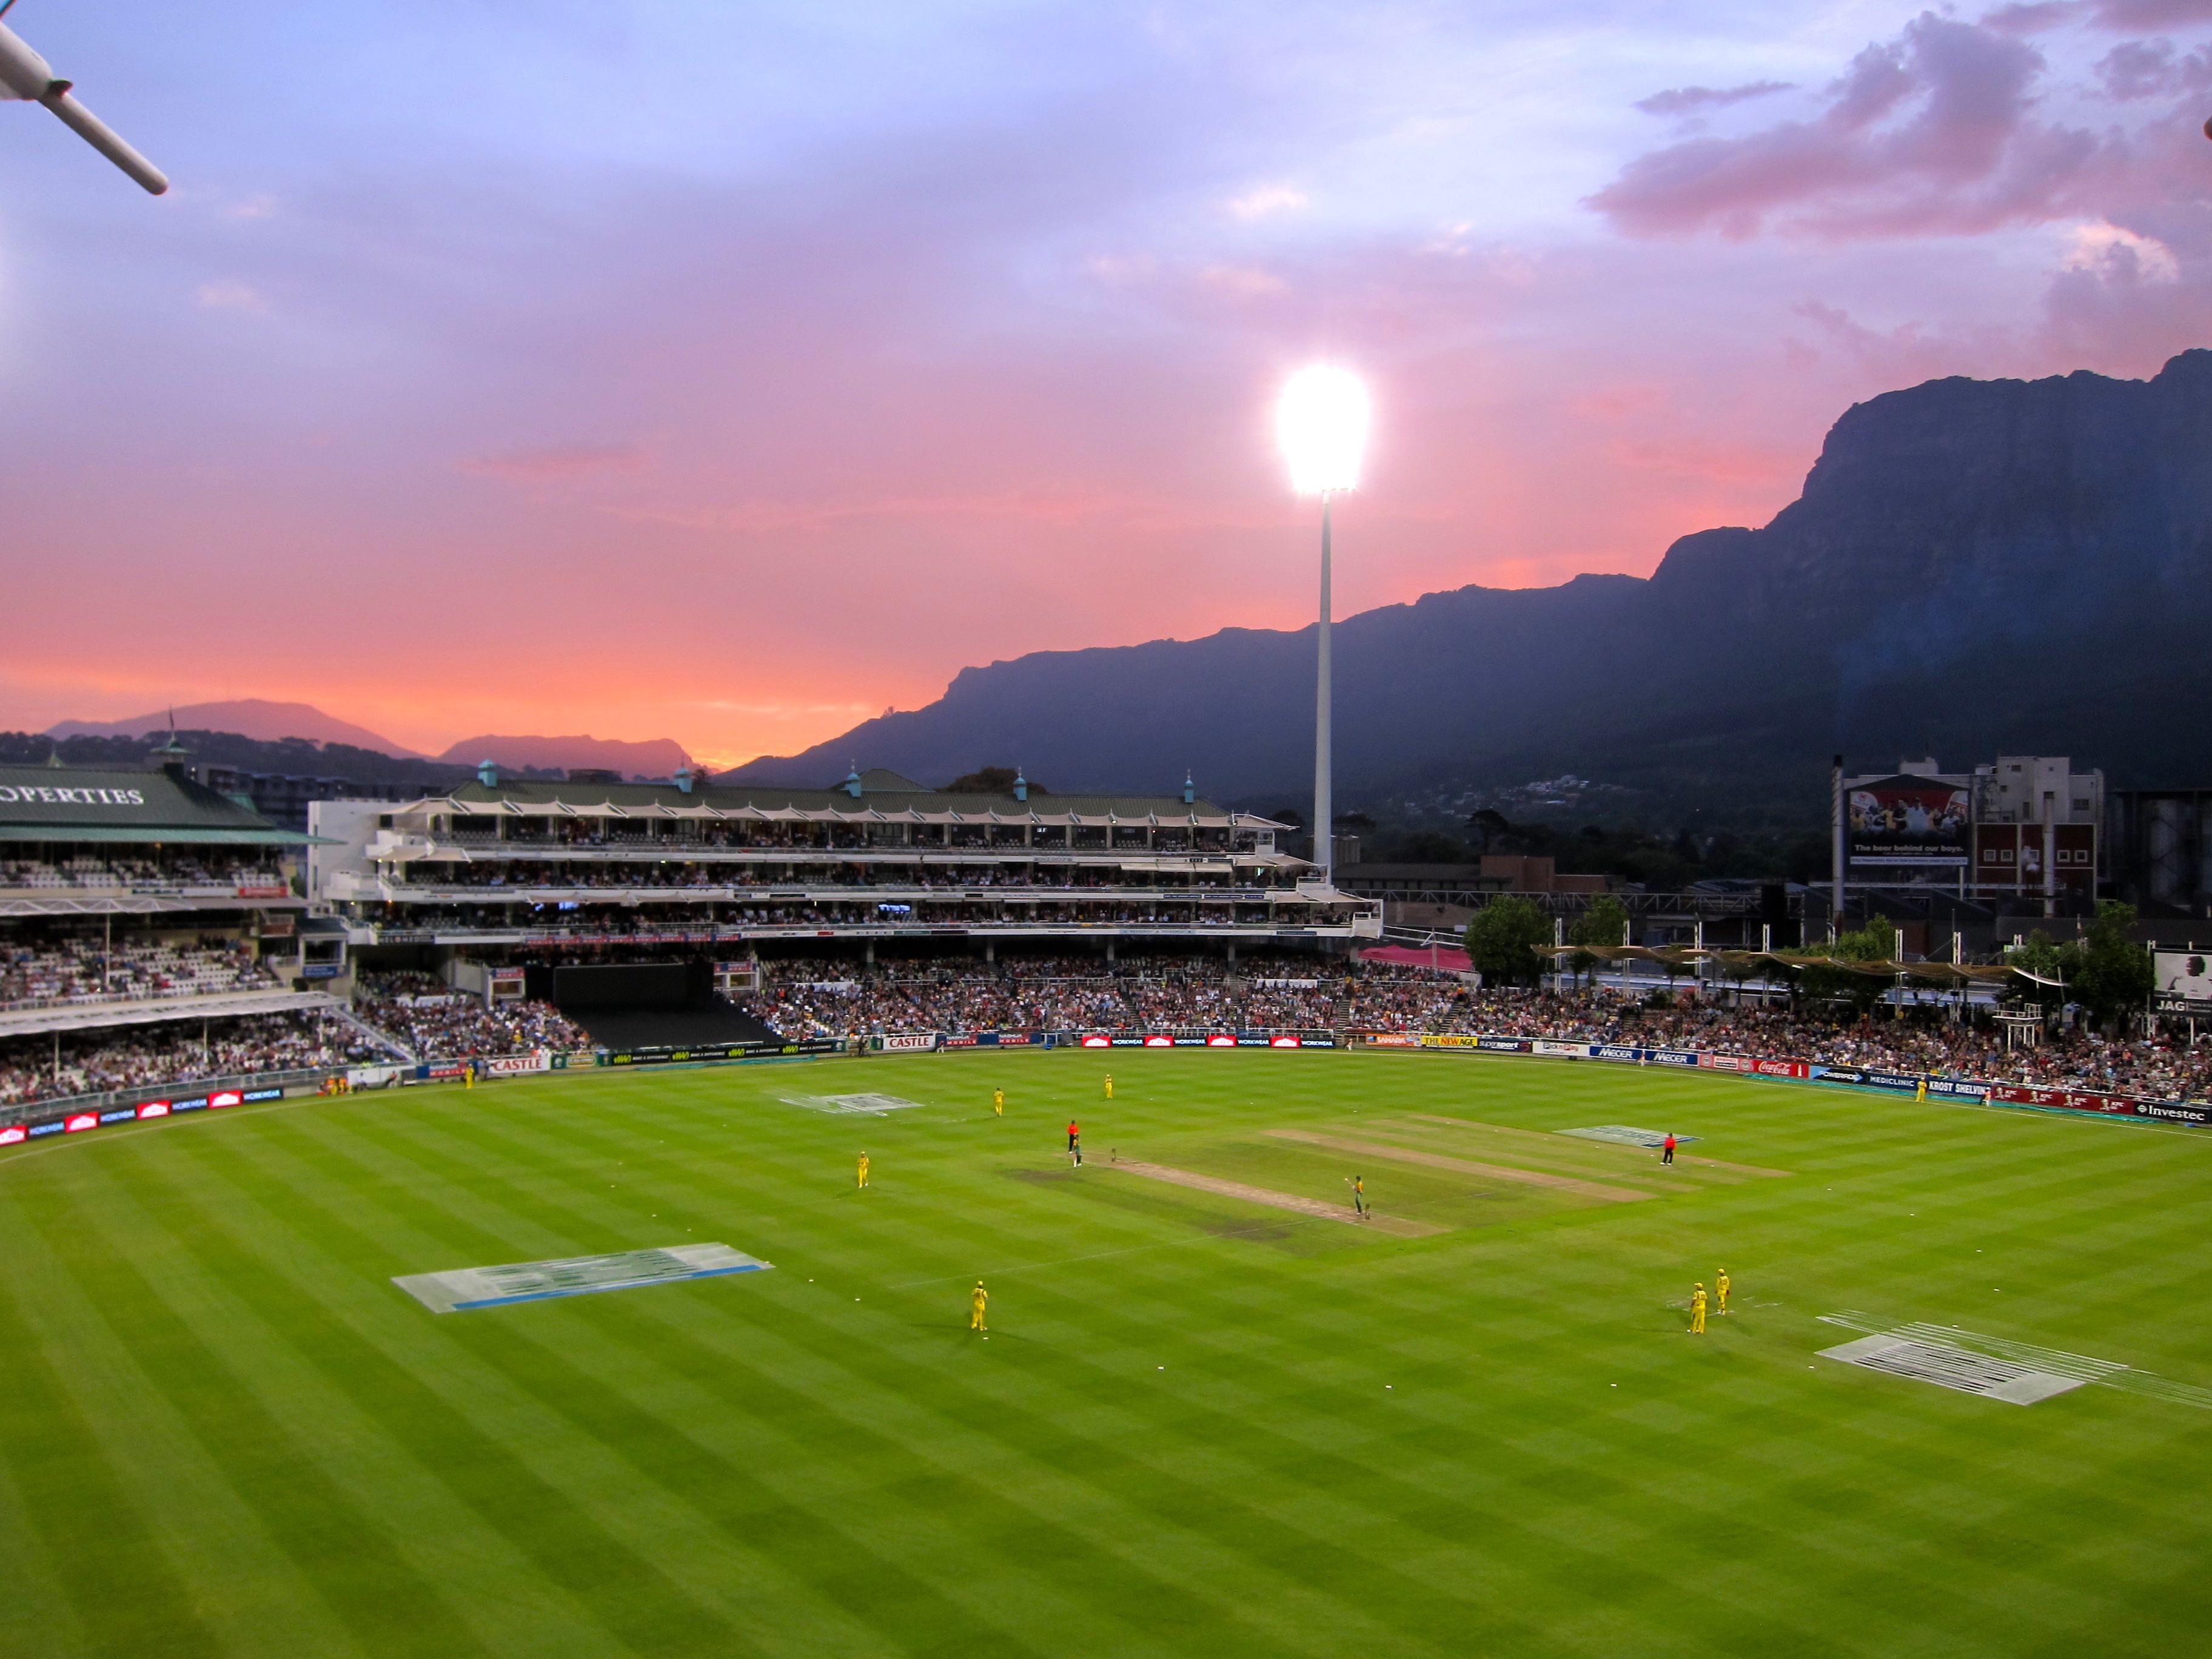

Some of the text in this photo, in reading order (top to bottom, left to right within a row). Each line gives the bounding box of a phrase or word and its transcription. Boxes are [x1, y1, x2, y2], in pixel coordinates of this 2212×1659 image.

[1941, 844, 1963, 853] boys.
[2156, 1000, 2185, 1011] JAG
[890, 1037, 929, 1048] CASTLE
[1598, 1048, 1633, 1059] MECER
[1654, 1052, 1687, 1063] MECER
[494, 1058, 541, 1071] CASTLE
[1758, 1061, 1791, 1074] Coca-Cola
[1819, 1071, 1859, 1081] POWERADE
[1869, 1076, 1915, 1087] MEDICLINIC
[1929, 1081, 1986, 1095] KROST SHELVIN
[2148, 1105, 2205, 1121] Investec
